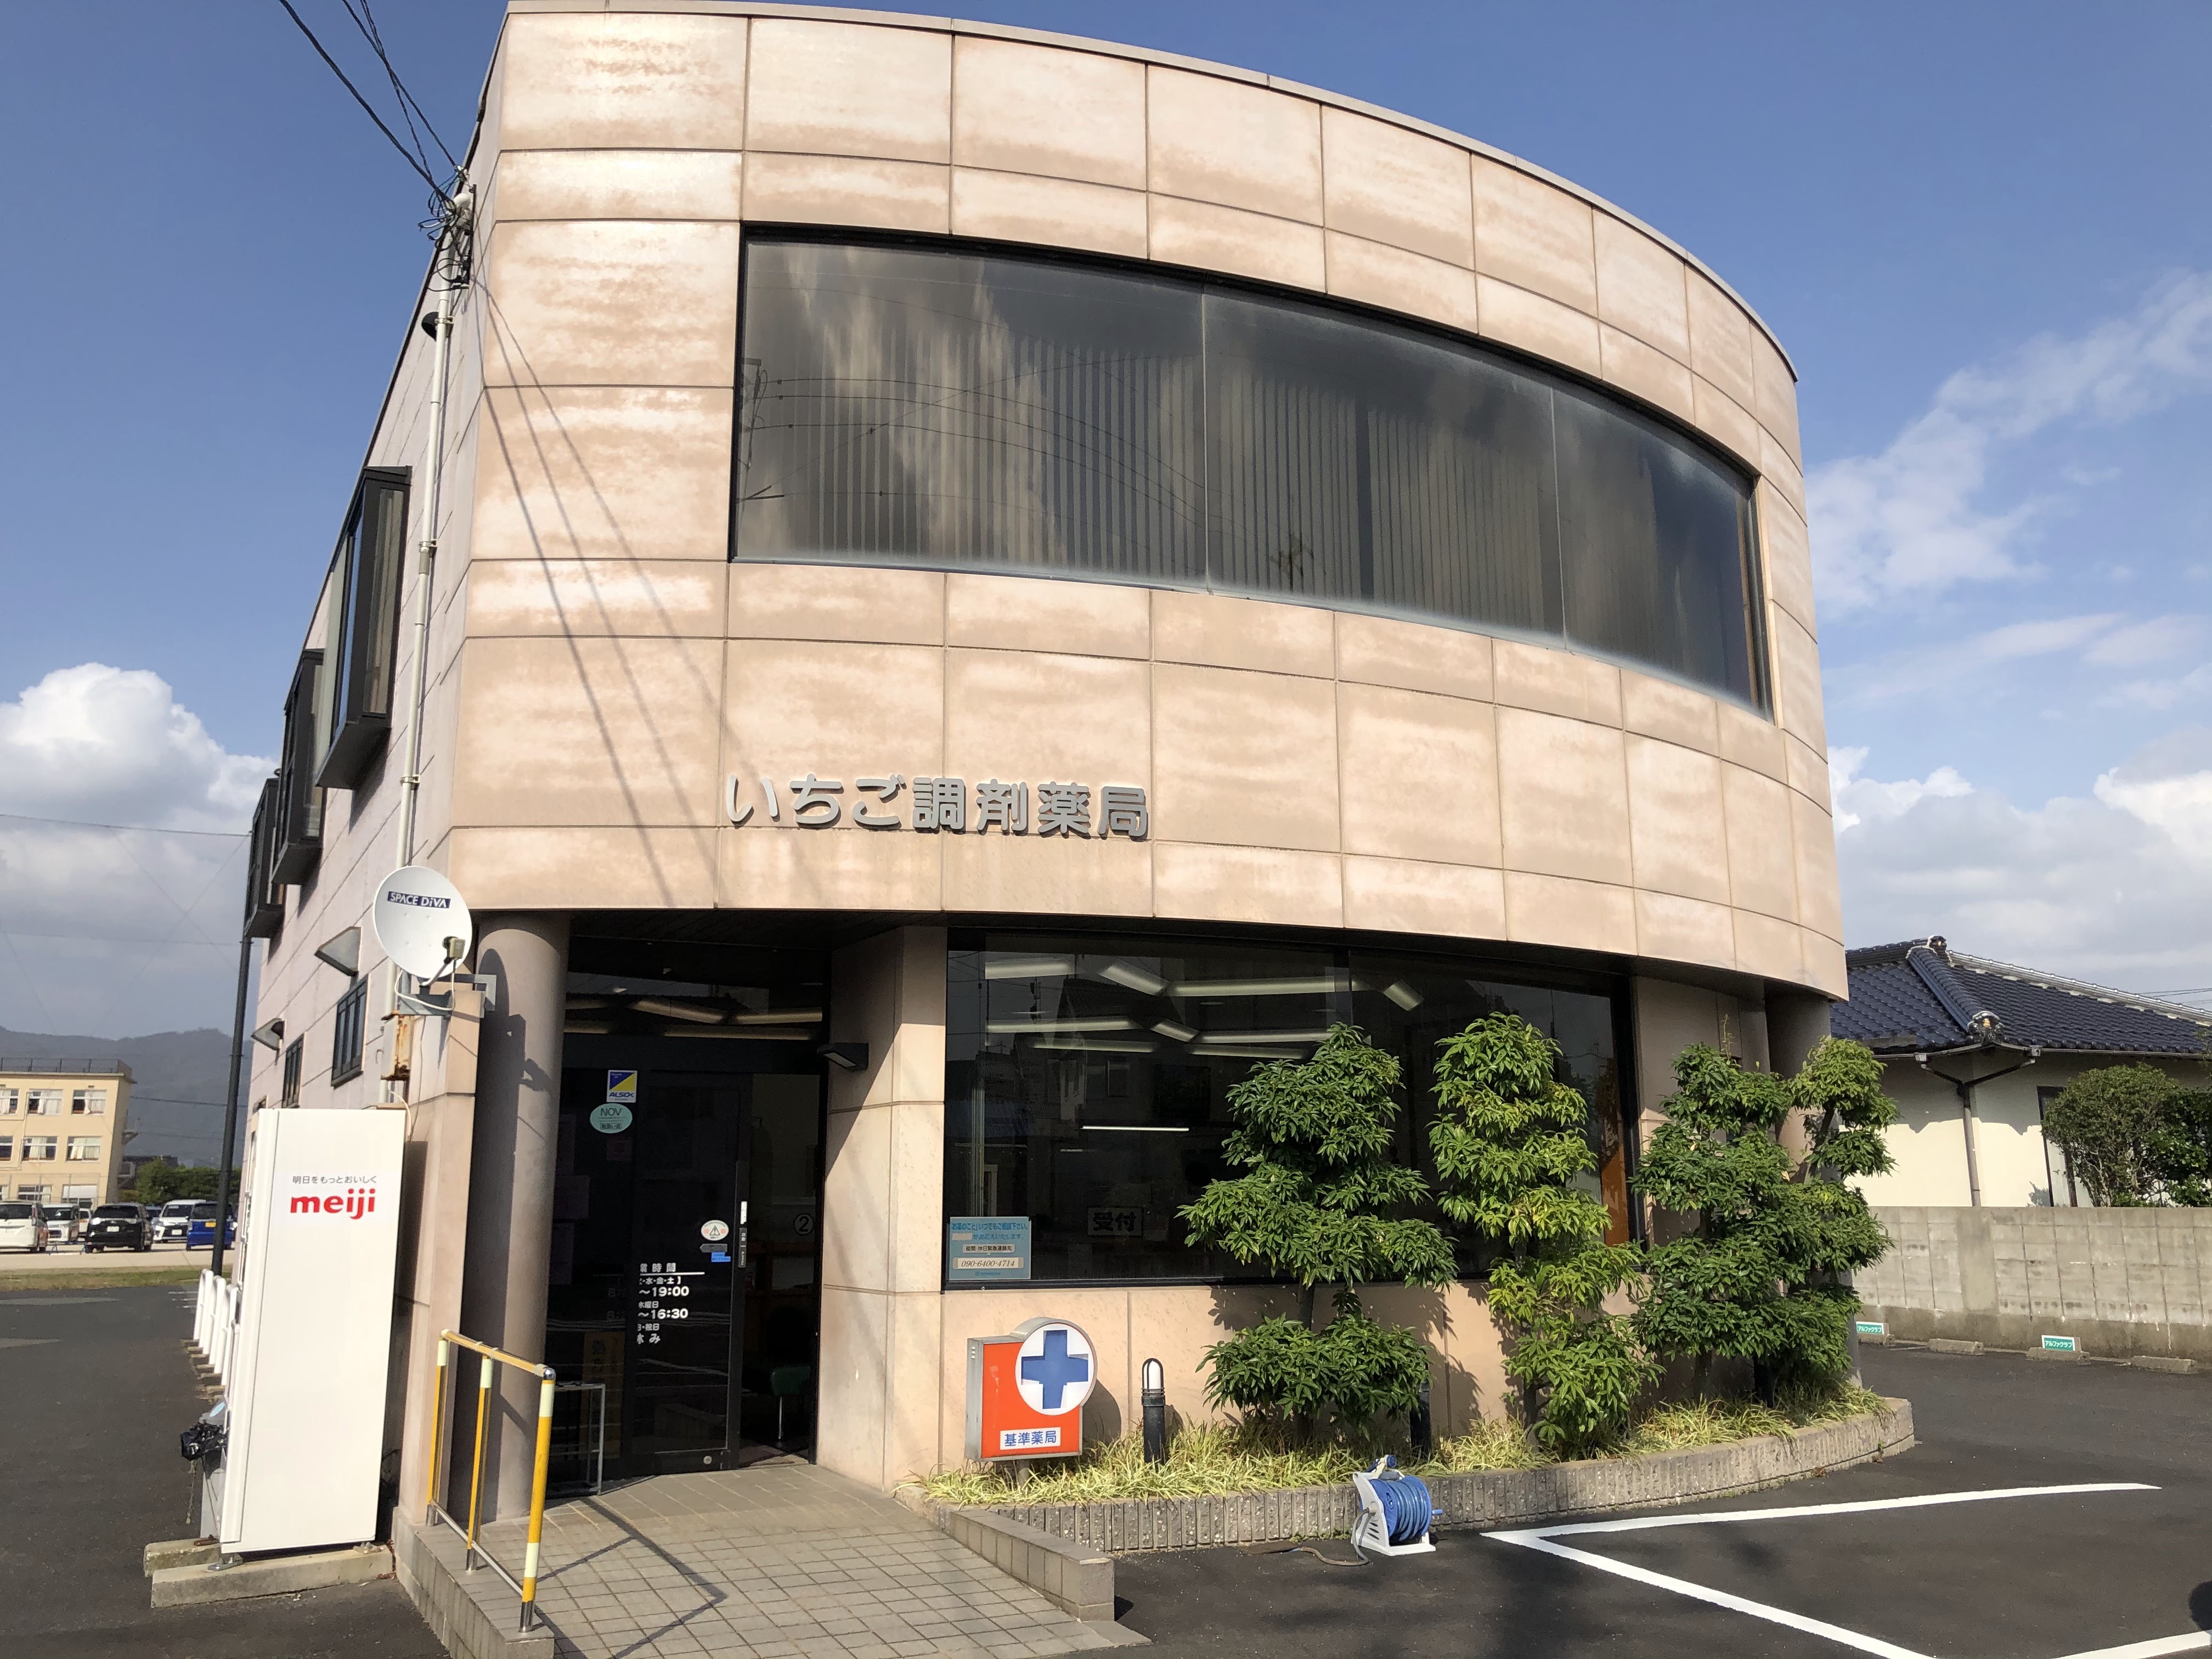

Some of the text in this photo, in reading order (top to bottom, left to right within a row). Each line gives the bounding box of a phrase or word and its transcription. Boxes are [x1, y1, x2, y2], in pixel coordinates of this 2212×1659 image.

[727, 773, 1147, 837] いちご調剤薬局
[390, 892, 418, 905] SPACE
[601, 1108, 622, 1116] NOV
[292, 1175, 377, 1184] 明日をもっとおいしく
[290, 1188, 376, 1220] meiji
[1093, 1212, 1136, 1233] 受付
[1004, 1430, 1057, 1447] 基準薬局
